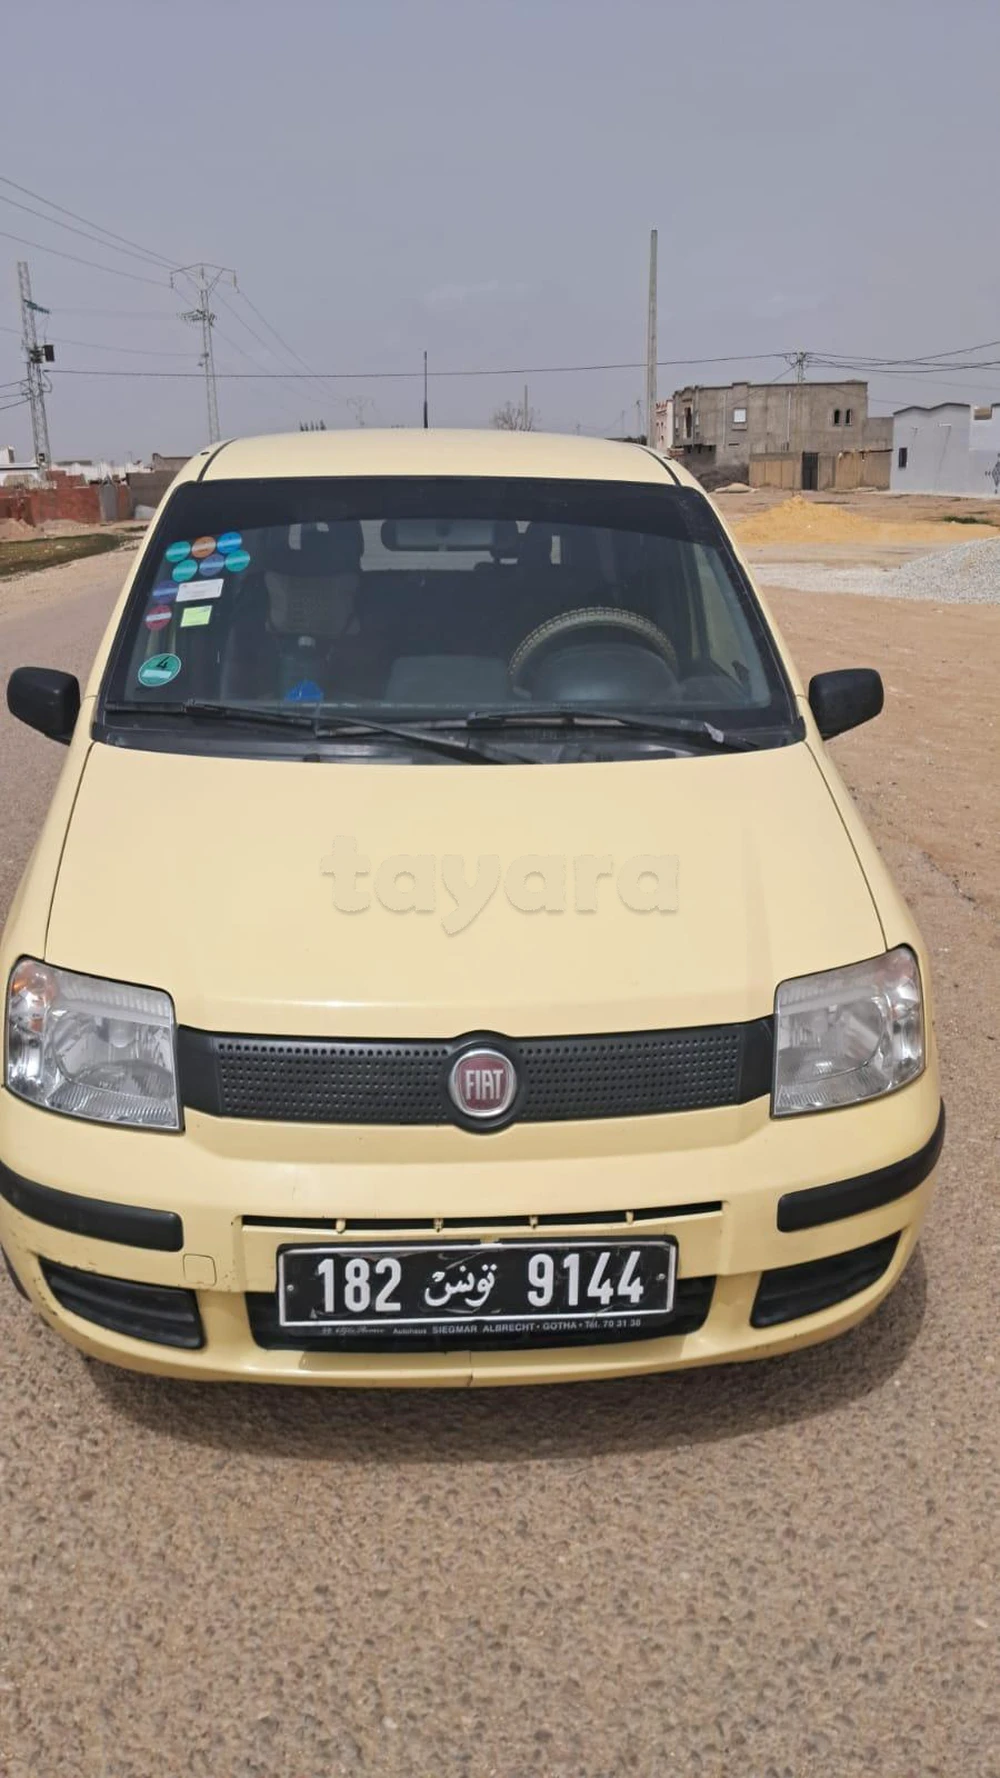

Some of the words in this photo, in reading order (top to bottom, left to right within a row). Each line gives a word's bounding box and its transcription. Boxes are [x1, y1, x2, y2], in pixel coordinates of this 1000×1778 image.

[156, 656, 170, 669] 4
[465, 1069, 504, 1101] FIAT
[317, 1257, 402, 1313] 182
[424, 1263, 497, 1307] تونس
[527, 1251, 645, 1307] 9144
[432, 1324, 478, 1334] SIEGMAR
[482, 1322, 535, 1333] ALBRECHT
[542, 1321, 577, 1331] GOTHA
